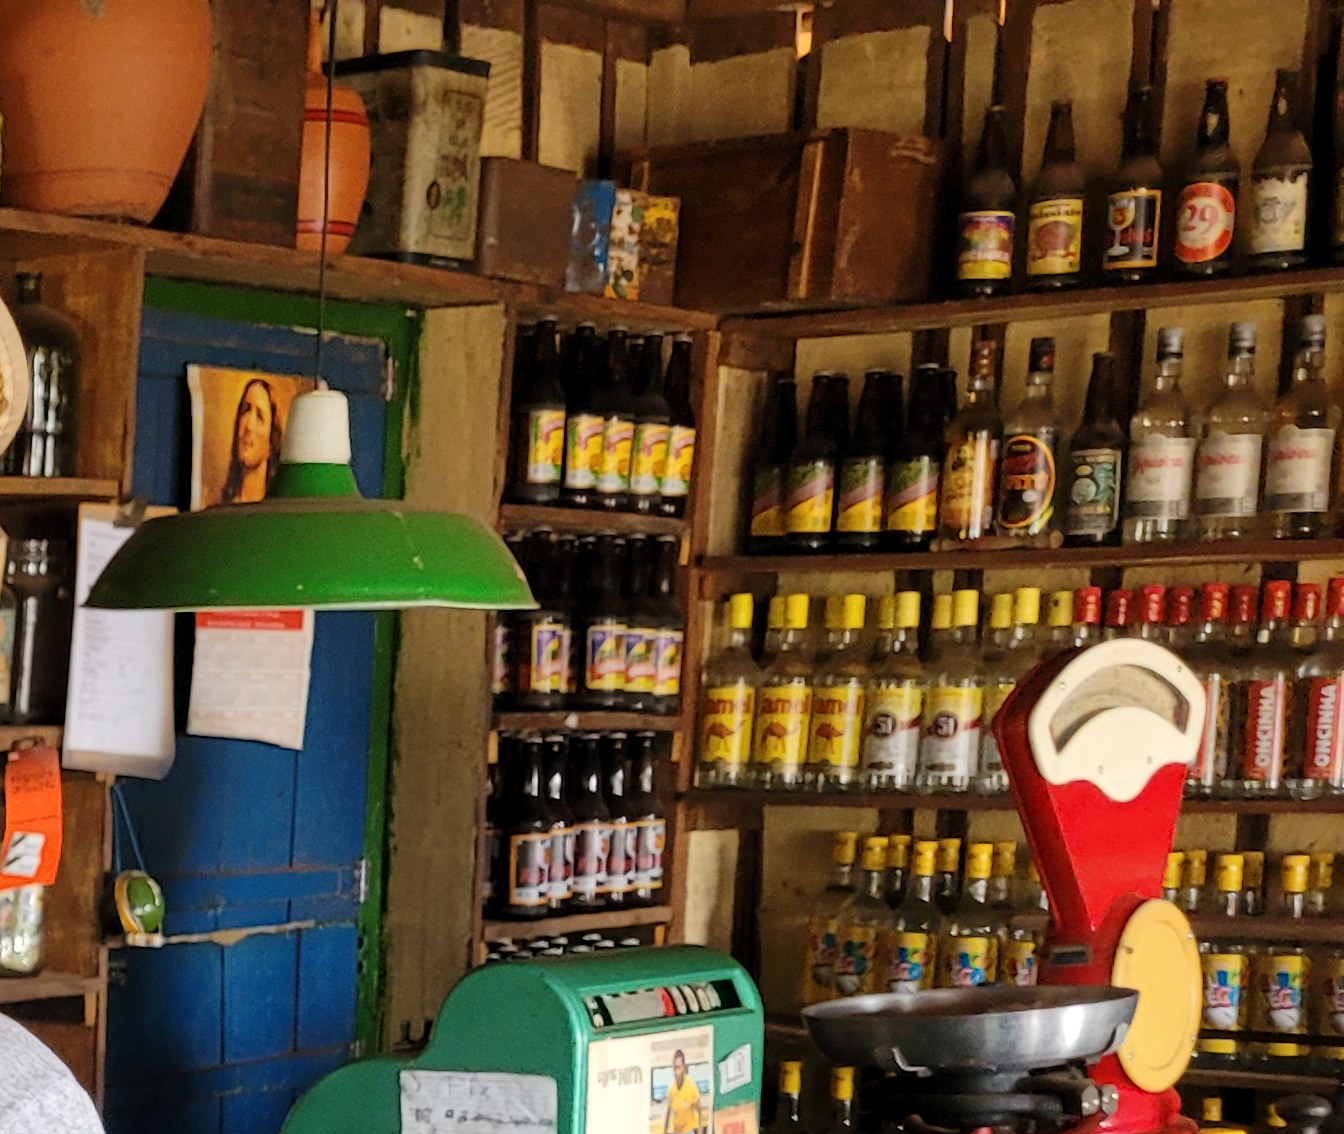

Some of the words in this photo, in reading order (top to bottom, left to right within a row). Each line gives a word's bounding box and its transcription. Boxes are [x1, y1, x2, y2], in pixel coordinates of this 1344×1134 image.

[937, 716, 956, 736] 51
[1254, 684, 1276, 767] ONCINHA
[1314, 684, 1337, 767] ONCINHA
